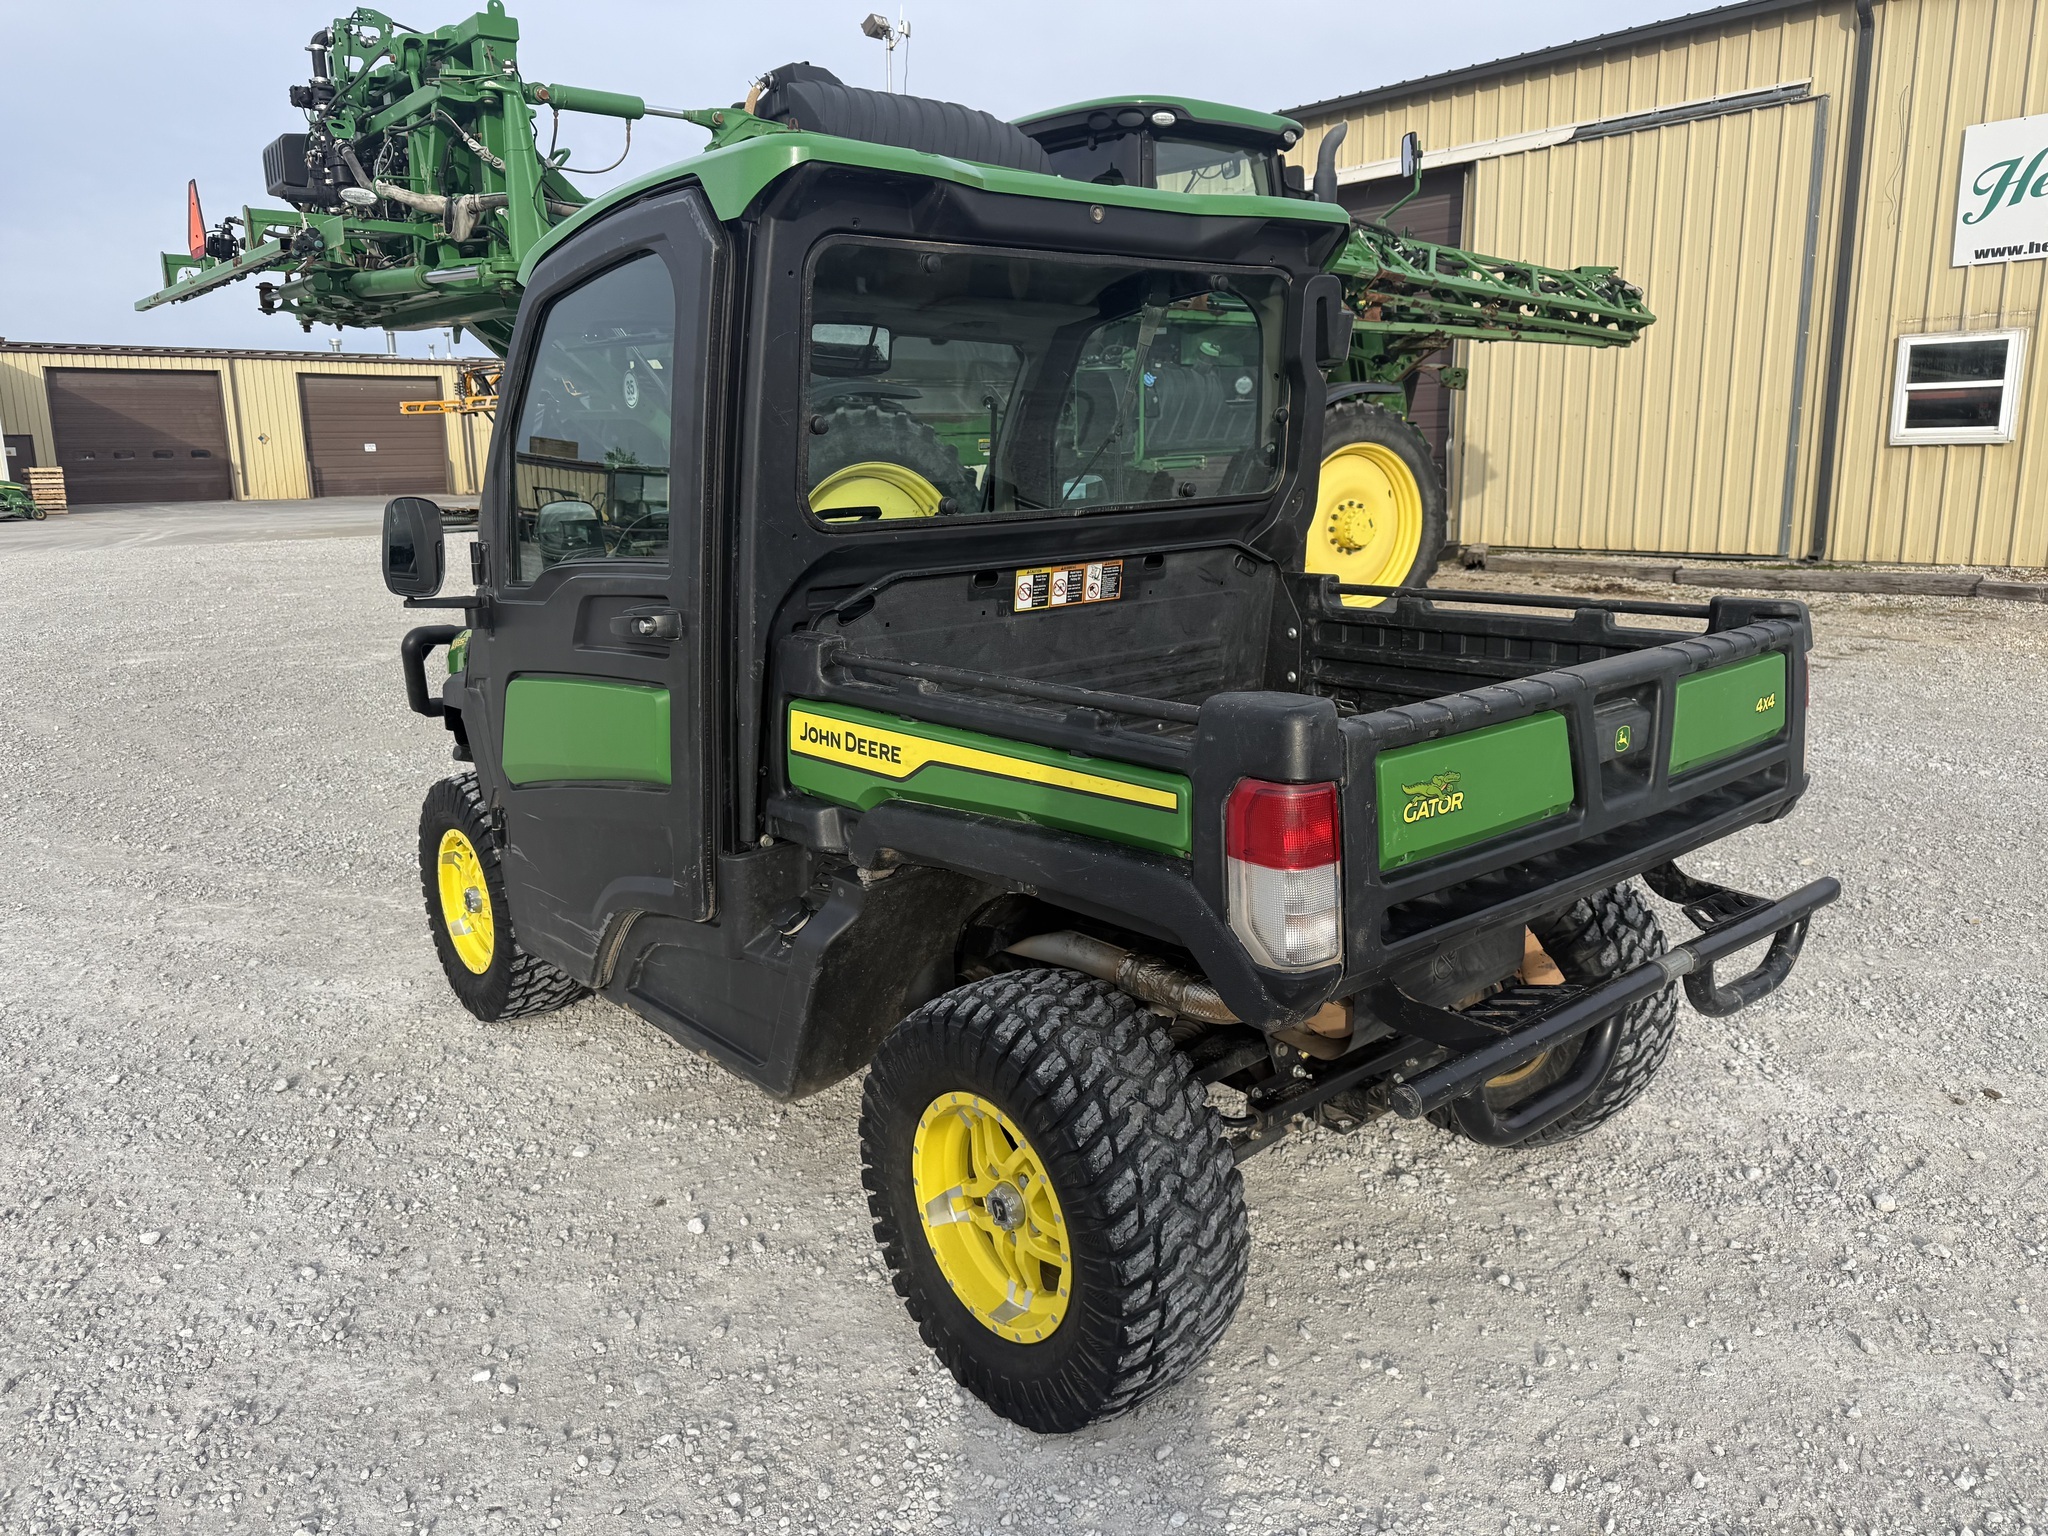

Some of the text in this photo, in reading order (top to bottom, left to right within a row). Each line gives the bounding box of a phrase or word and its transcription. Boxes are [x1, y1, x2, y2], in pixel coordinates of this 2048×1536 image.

[800, 722, 902, 764] JOHN DEERE
[1403, 792, 1464, 824] GATOR
